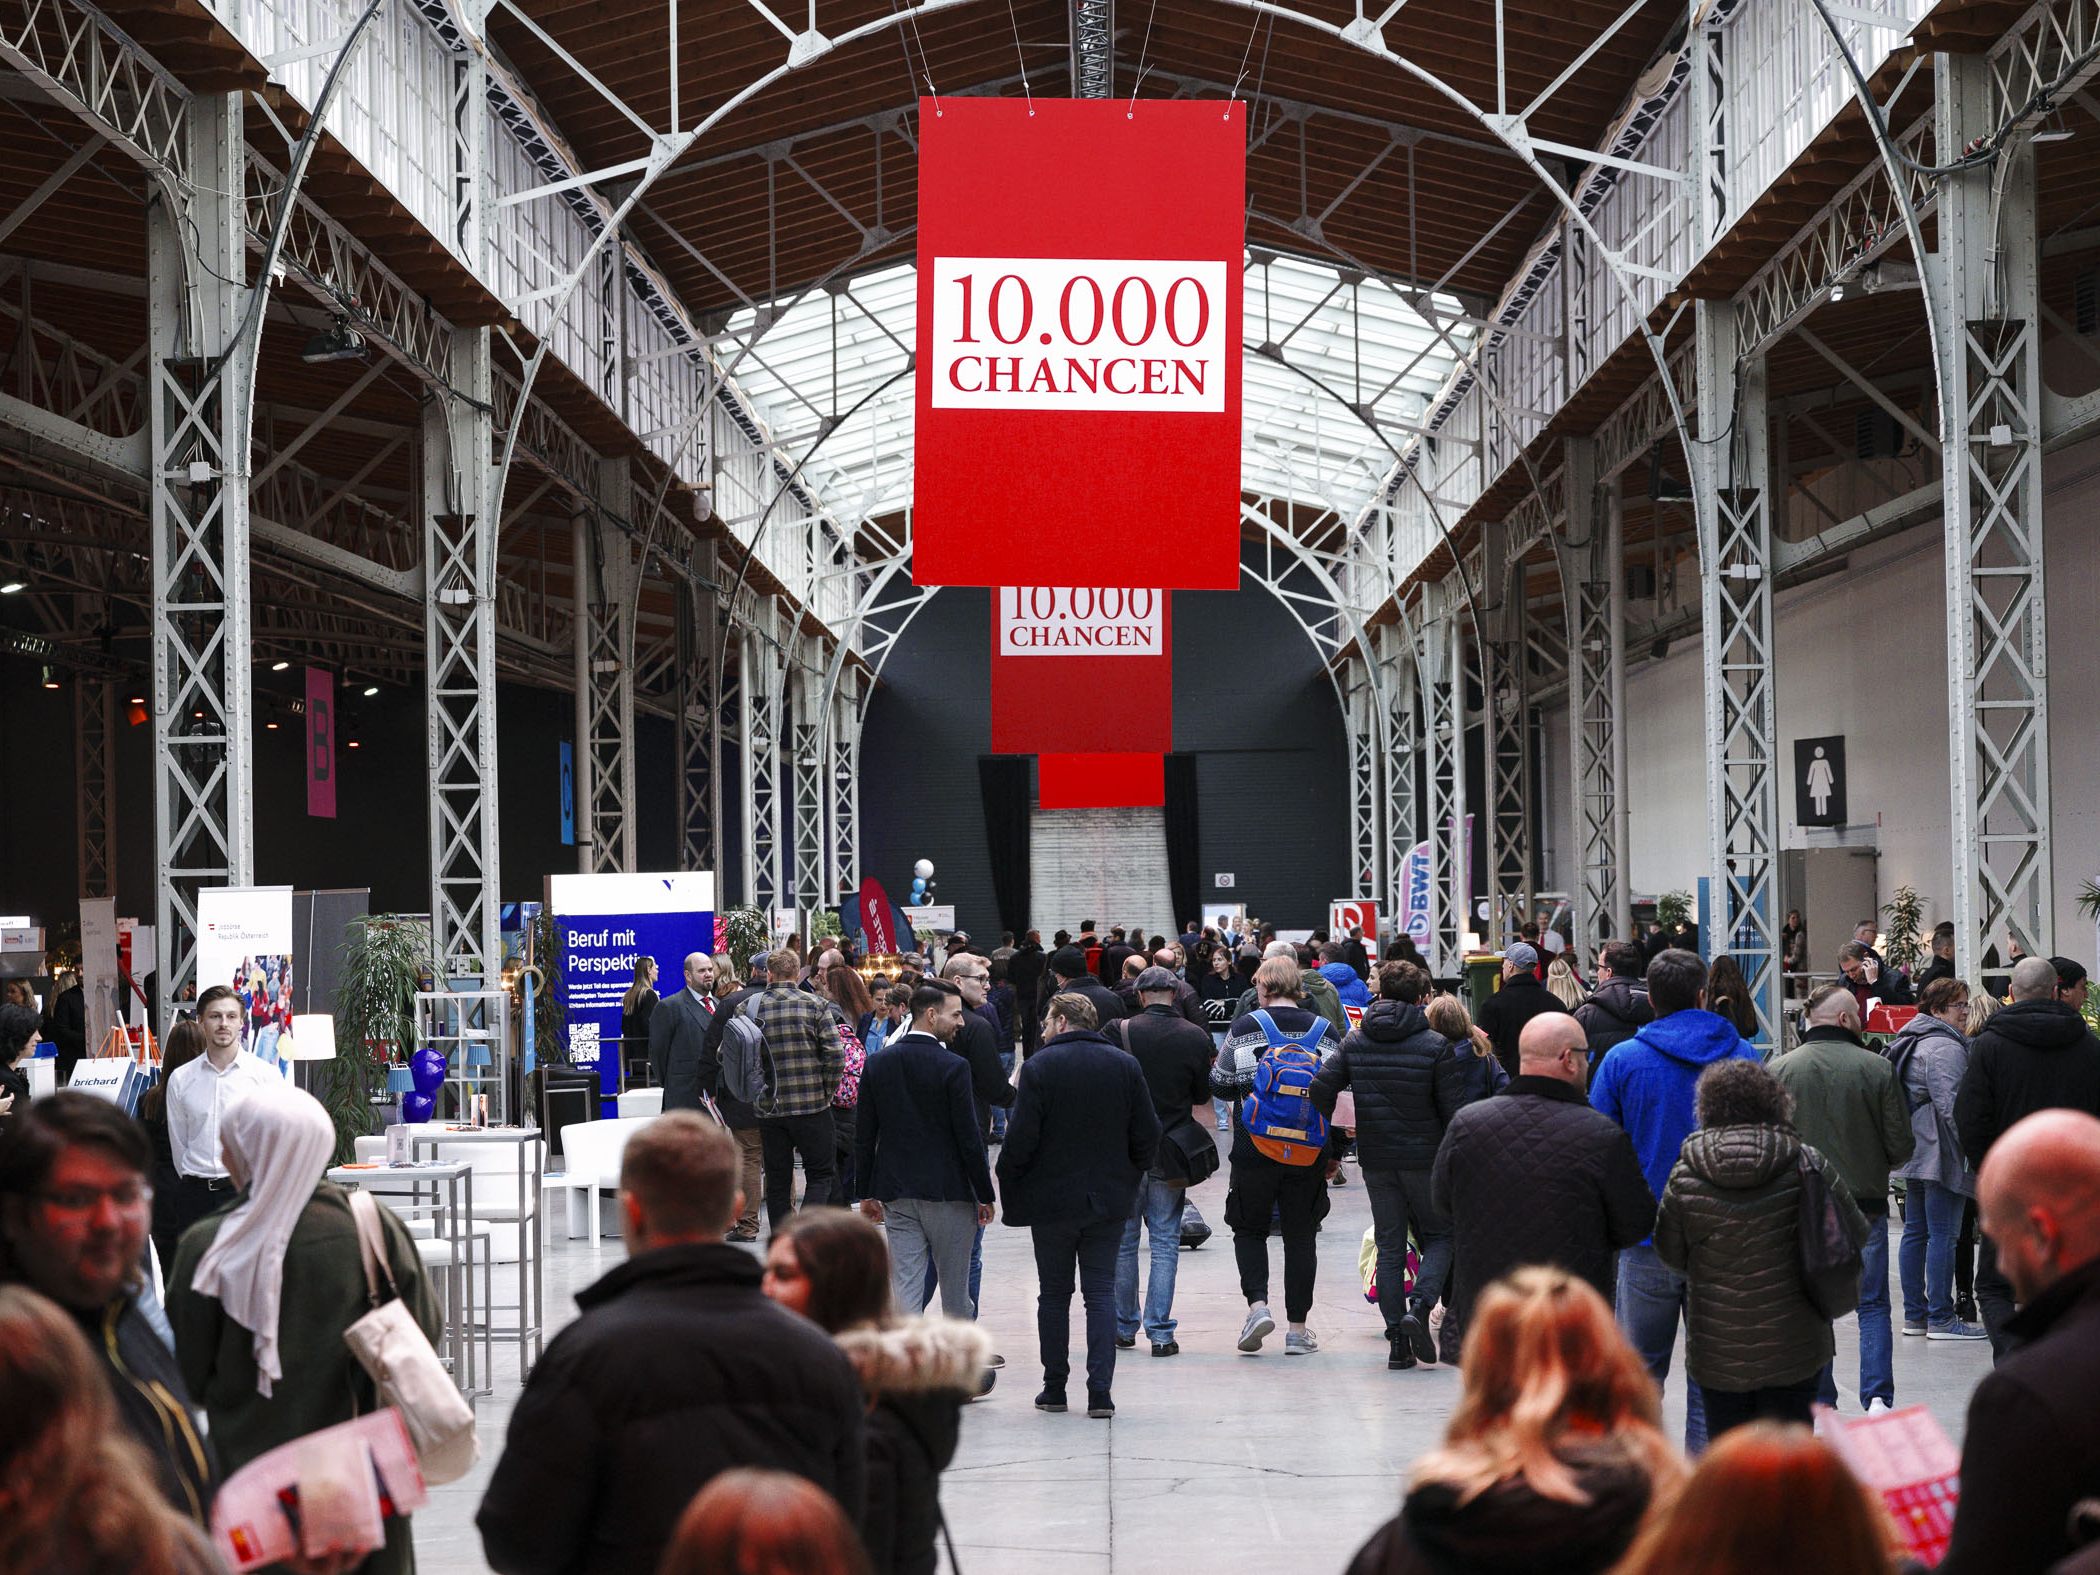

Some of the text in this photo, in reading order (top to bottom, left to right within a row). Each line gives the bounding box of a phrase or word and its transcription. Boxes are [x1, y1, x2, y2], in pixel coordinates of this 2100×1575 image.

[952, 274, 1210, 348] 10.000
[949, 356, 1210, 396] CHANCEN
[1011, 587, 1153, 621] 10.000
[1009, 625, 1153, 647] CHANCEN
[312, 698, 329, 781] B
[1411, 854, 1430, 910] BWT
[568, 929, 636, 947] Beruf mit
[74, 1077, 119, 1087] brichard
